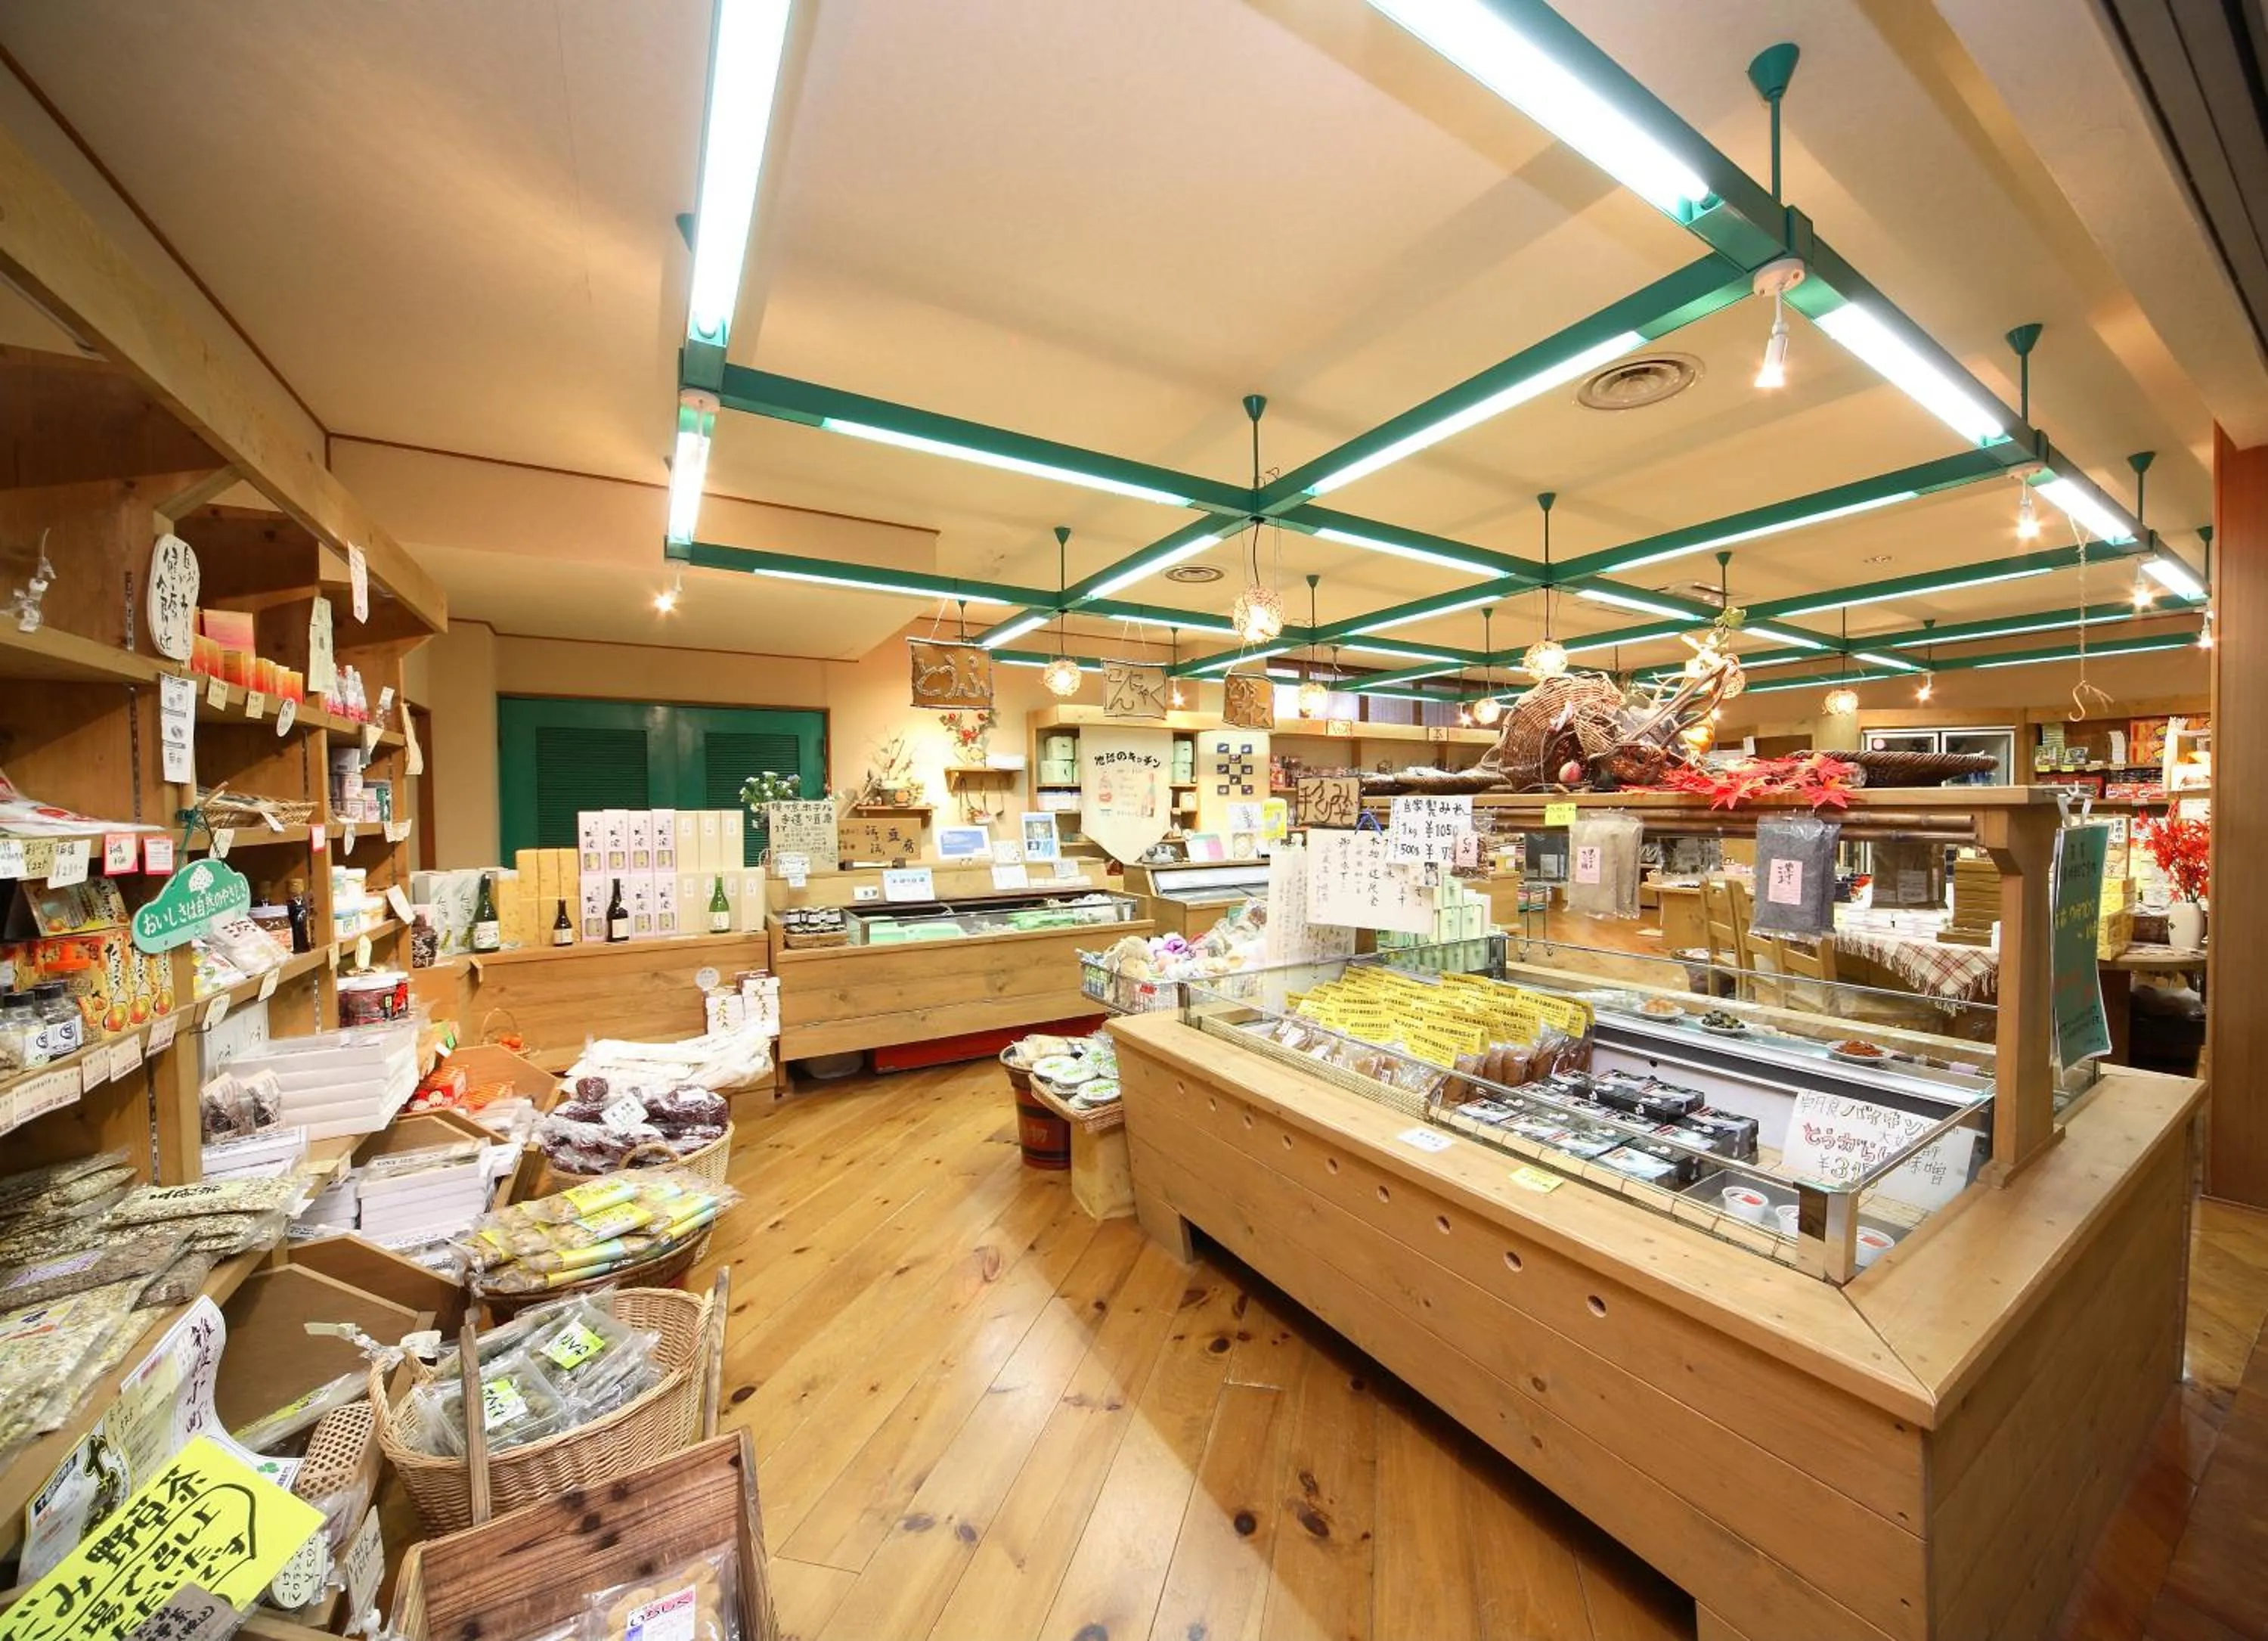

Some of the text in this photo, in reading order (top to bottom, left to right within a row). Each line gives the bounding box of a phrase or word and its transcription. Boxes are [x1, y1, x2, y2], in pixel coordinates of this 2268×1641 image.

[1108, 668, 1165, 710] こんにゃく
[143, 879, 246, 936] おいしさは自然のやさしさ
[1802, 1092, 1959, 1136] 朝食バイキン
